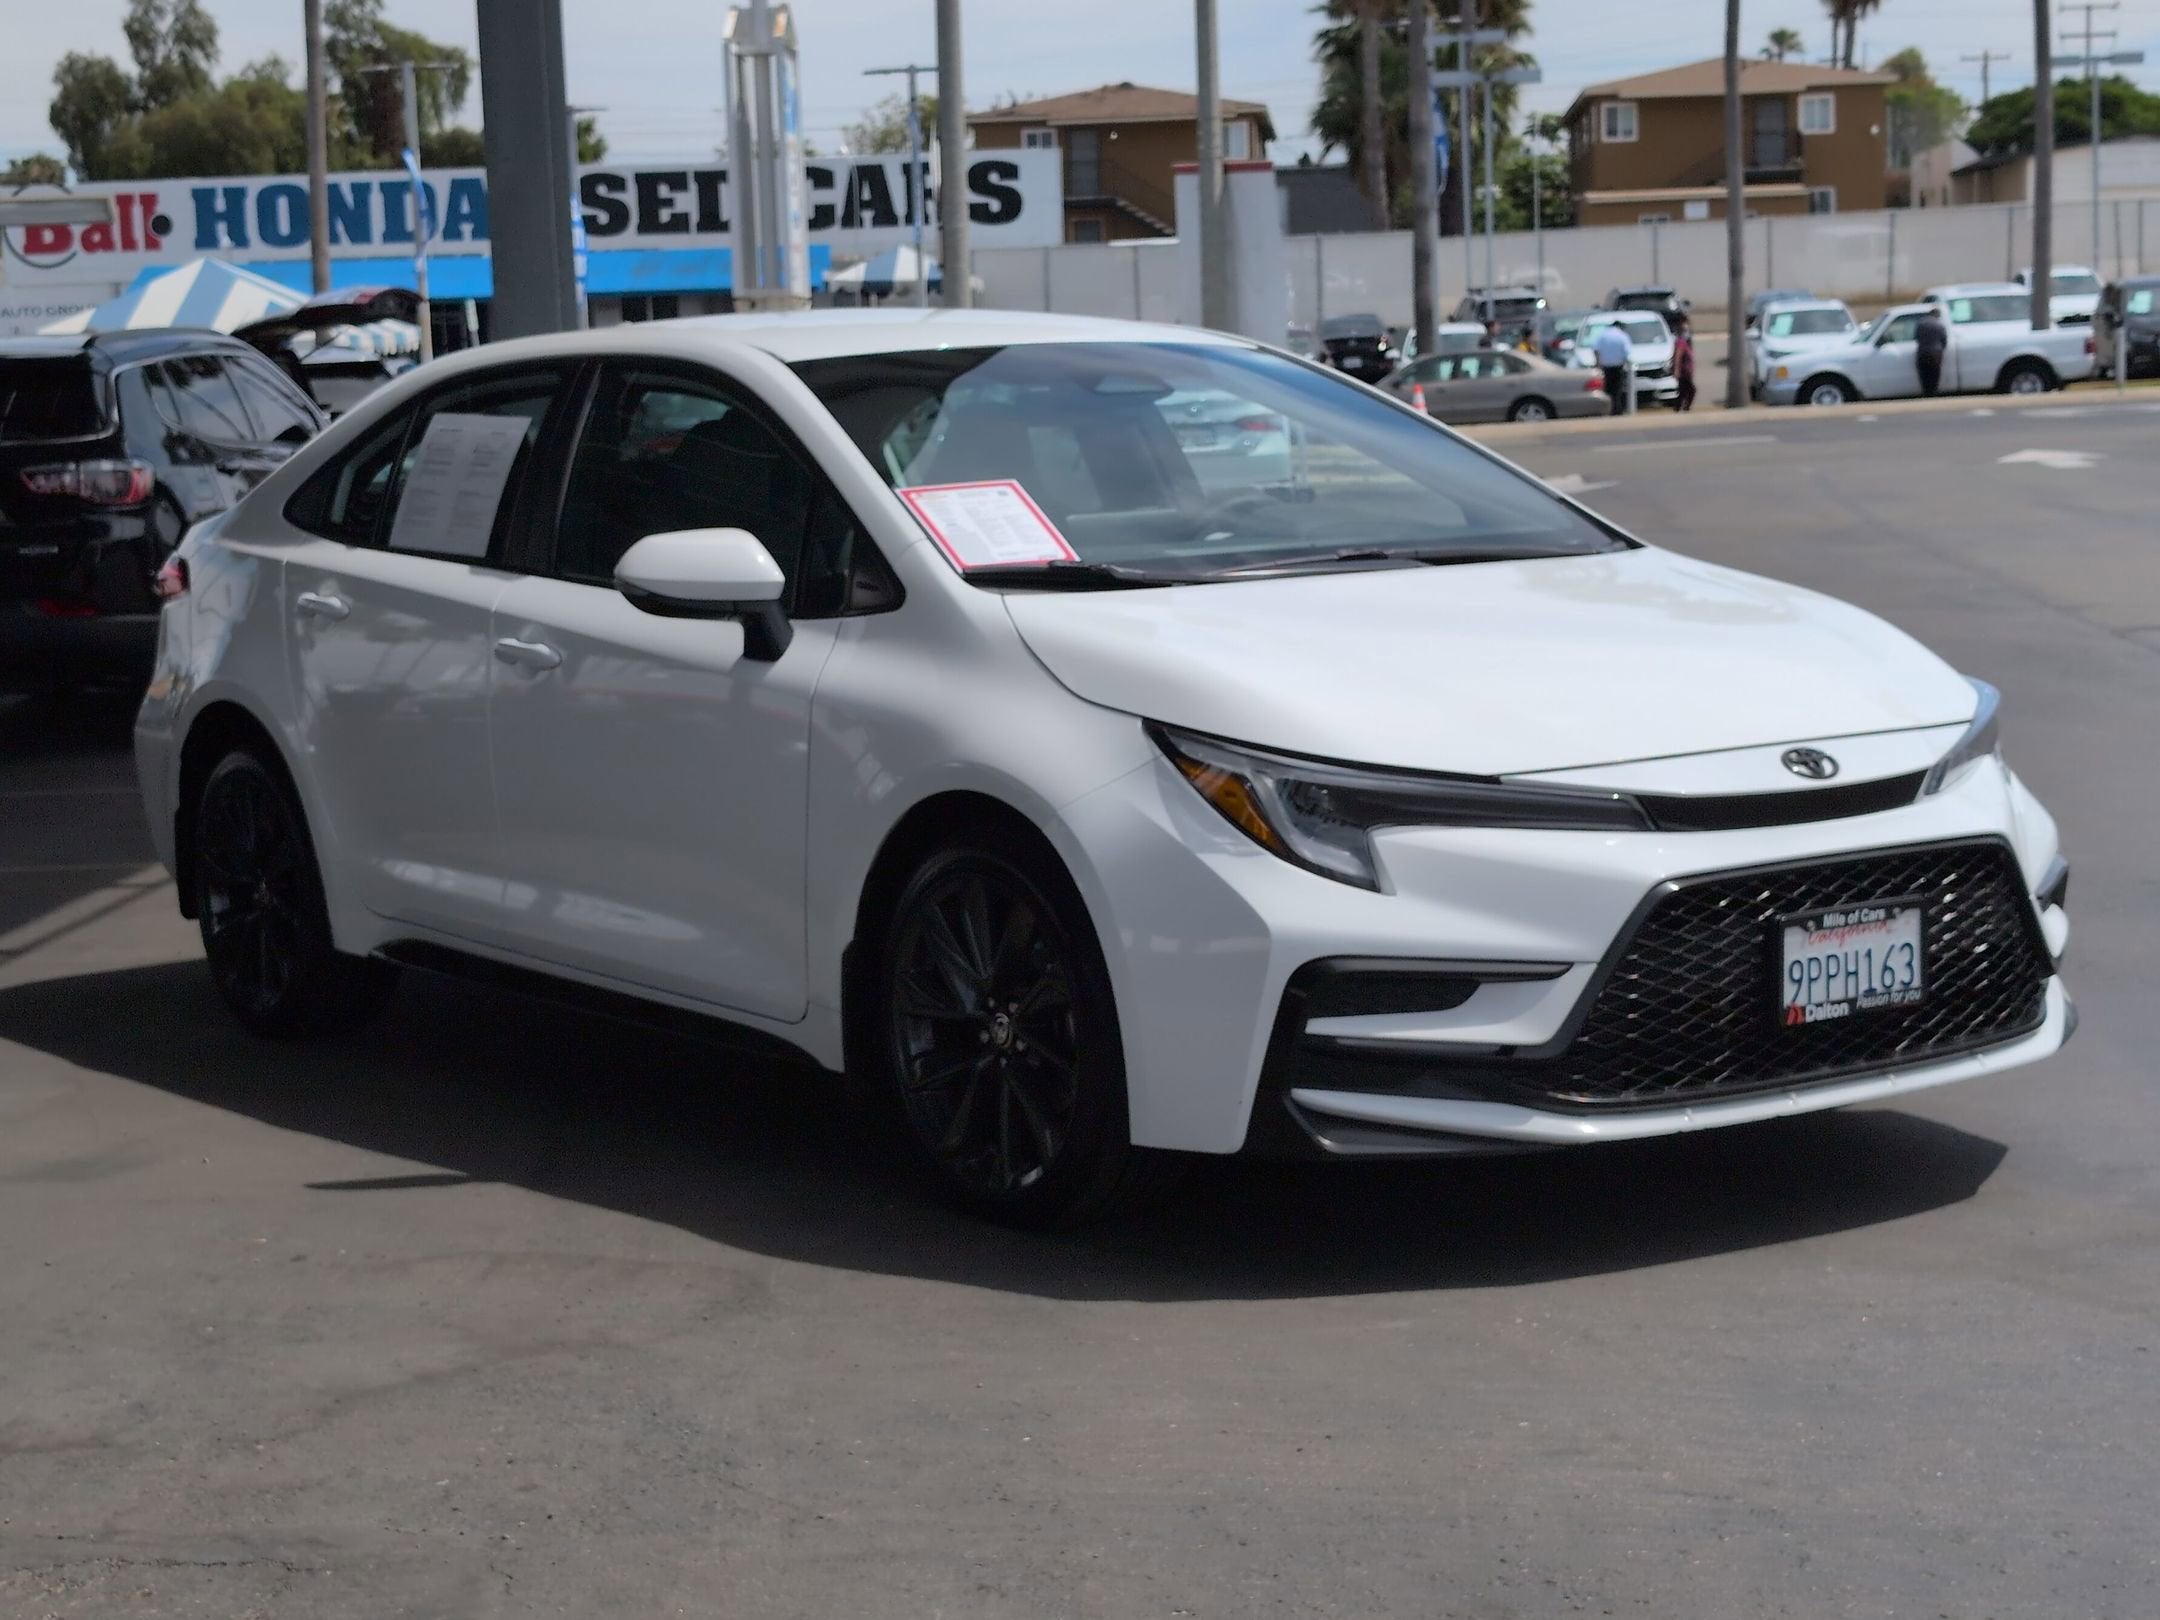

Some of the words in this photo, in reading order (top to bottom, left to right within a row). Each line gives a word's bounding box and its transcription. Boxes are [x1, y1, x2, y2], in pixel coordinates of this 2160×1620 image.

[192, 178, 490, 249] HONDA
[1823, 913, 1845, 928] Mile
[1847, 909, 1859, 923] of
[1861, 908, 1886, 923] Cars
[1808, 919, 1893, 948] California
[1788, 942, 1914, 1005] 9PPH163
[1805, 1002, 1849, 1022] Dalton
